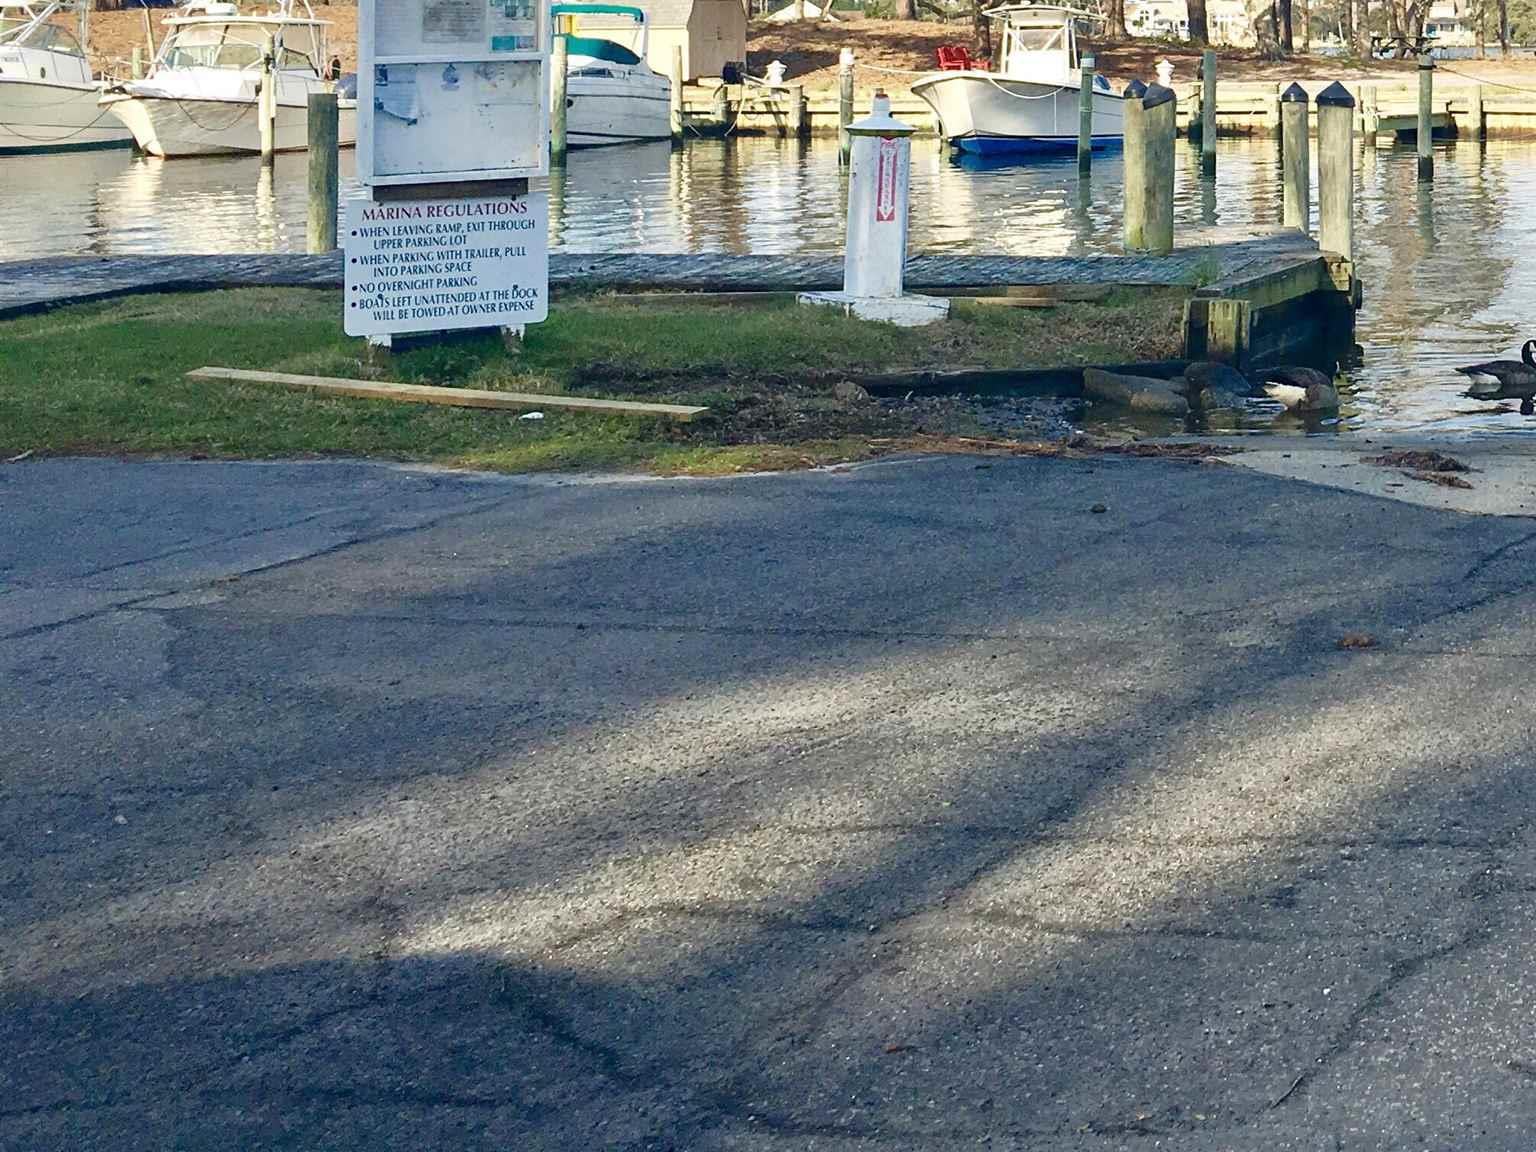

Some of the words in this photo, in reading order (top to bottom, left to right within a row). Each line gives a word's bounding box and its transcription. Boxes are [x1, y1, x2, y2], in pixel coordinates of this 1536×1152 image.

[362, 206, 422, 221] MARINA
[426, 201, 528, 218] REGULATIONS
[359, 227, 390, 238] WHEN
[392, 224, 433, 236] LEAVING
[435, 222, 464, 234] RAMP,
[466, 221, 485, 233] EXIT
[487, 219, 535, 231] THROUGH
[373, 238, 403, 250] UPPER
[405, 236, 447, 248] PARKING
[449, 234, 467, 246] LOT
[359, 255, 390, 265] WHEN
[392, 251, 434, 263] PARKING
[437, 249, 462, 260] WITH
[465, 247, 502, 260] TRAILER,
[504, 246, 526, 257] PULL
[373, 266, 398, 277] INTO
[400, 263, 442, 275] PARKING
[444, 261, 472, 273] SPACE
[359, 282, 375, 293] NO
[377, 279, 434, 292] OVERNIGHT
[436, 276, 478, 289] PARKING
[359, 297, 390, 309] BOATS
[392, 295, 412, 307] LEFT
[414, 292, 477, 306] UNATTENDED
[478, 290, 490, 301] AT
[493, 289, 510, 300] THE
[511, 287, 538, 299] DOCK
[373, 310, 395, 321] WILL
[398, 308, 409, 319] BE
[411, 306, 446, 318] TOWED
[447, 305, 459, 316] AT
[461, 303, 497, 315] OWNER
[498, 300, 535, 312] EXPENSE
